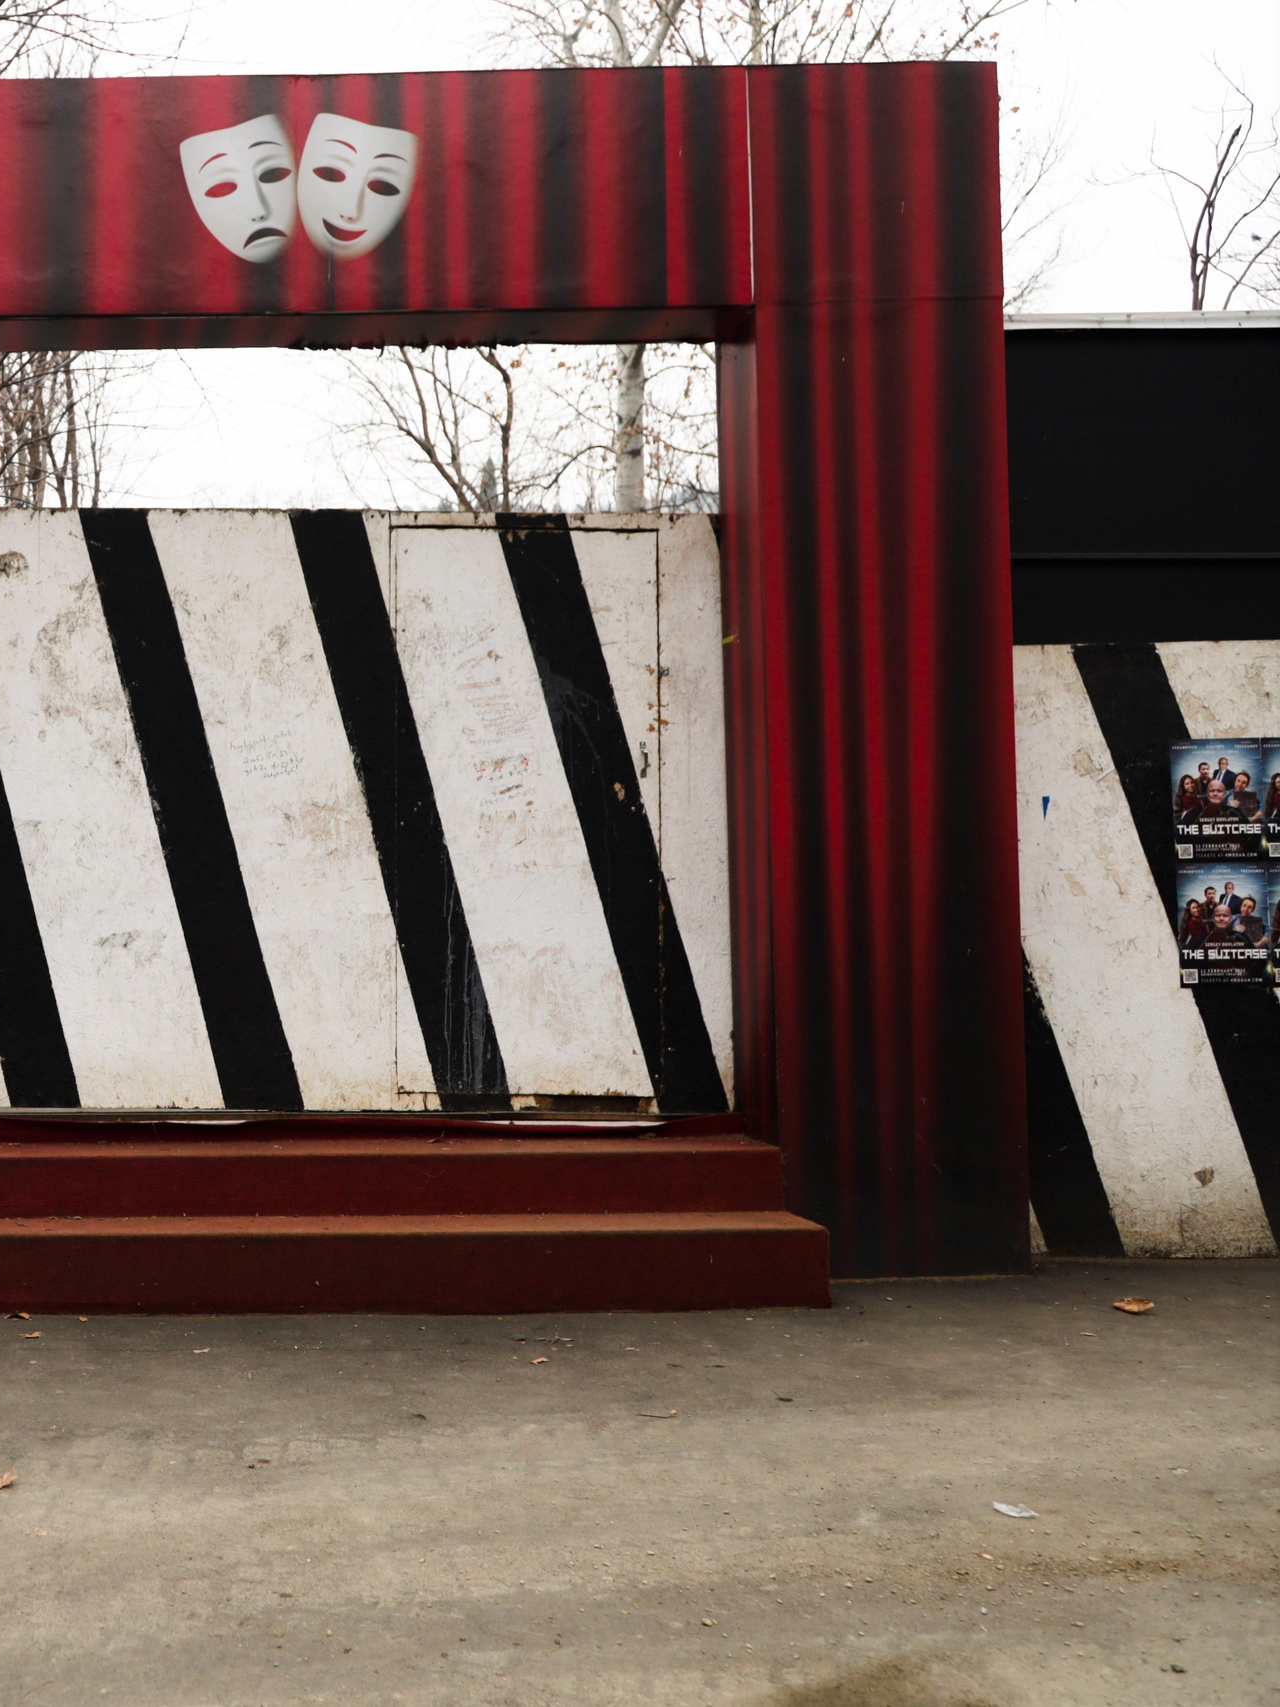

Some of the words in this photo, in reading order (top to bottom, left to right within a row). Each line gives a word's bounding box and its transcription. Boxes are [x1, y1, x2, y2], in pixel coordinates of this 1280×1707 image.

[1177, 824, 1199, 835] THE
[1202, 823, 1262, 835] SUITCASE
[1182, 949, 1205, 960] THE
[1207, 948, 1268, 960] SUITCASE
